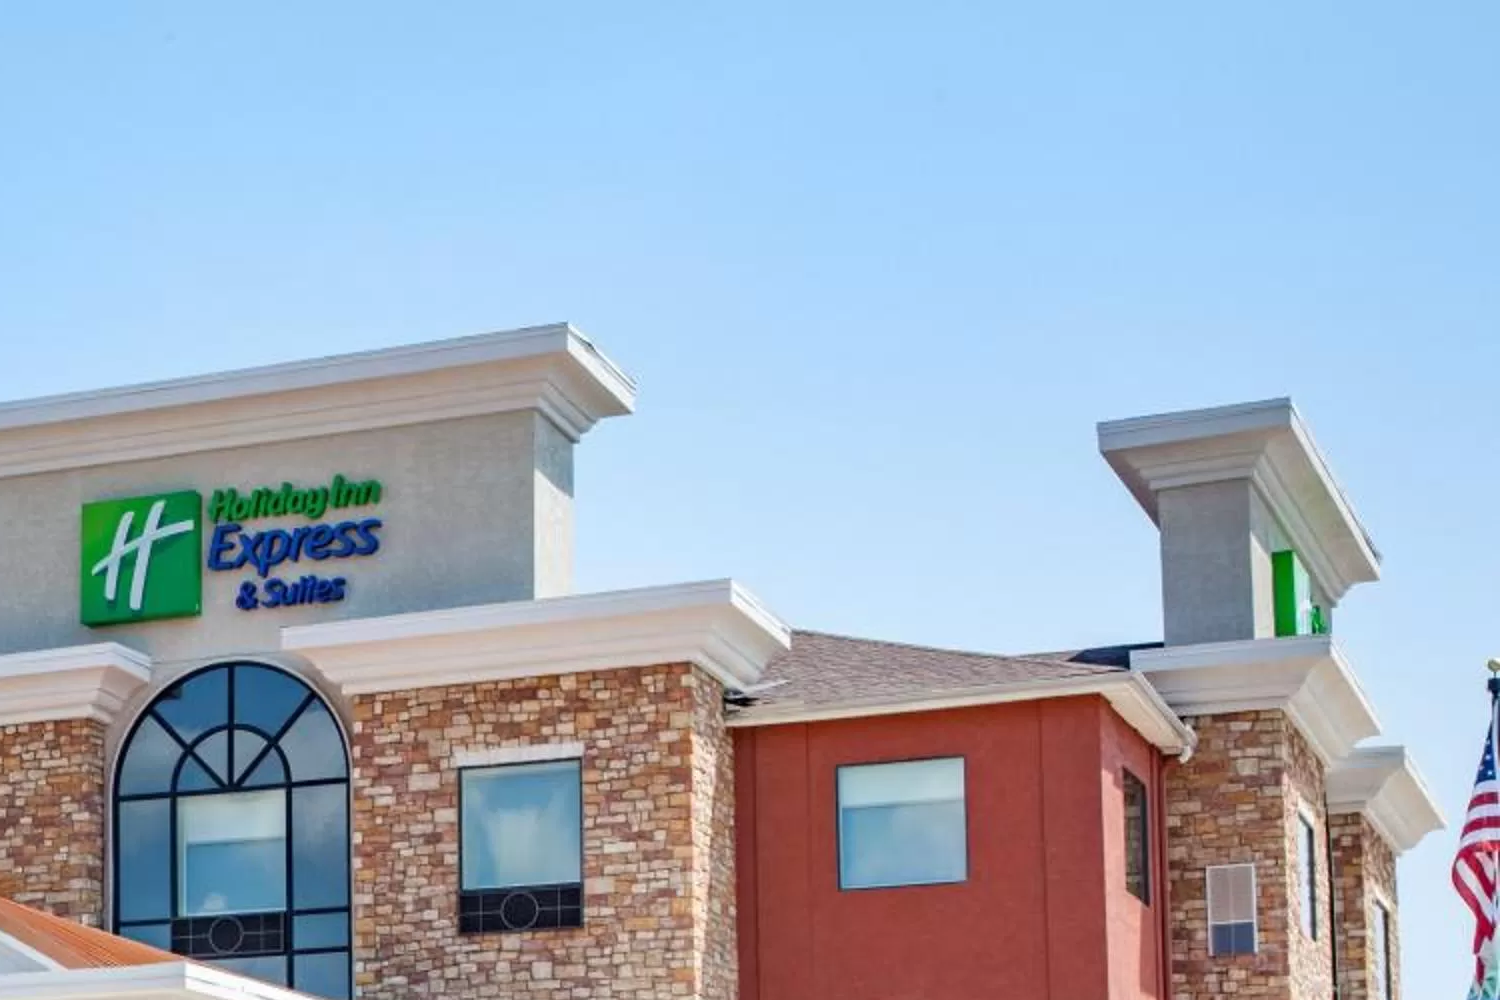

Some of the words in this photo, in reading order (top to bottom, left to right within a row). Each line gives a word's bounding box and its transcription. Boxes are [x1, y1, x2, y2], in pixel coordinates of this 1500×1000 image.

[208, 482, 328, 523] Holiday
[331, 474, 381, 508] Inn
[207, 518, 382, 578] Express
[236, 581, 258, 610] &
[261, 575, 346, 609] Suites
